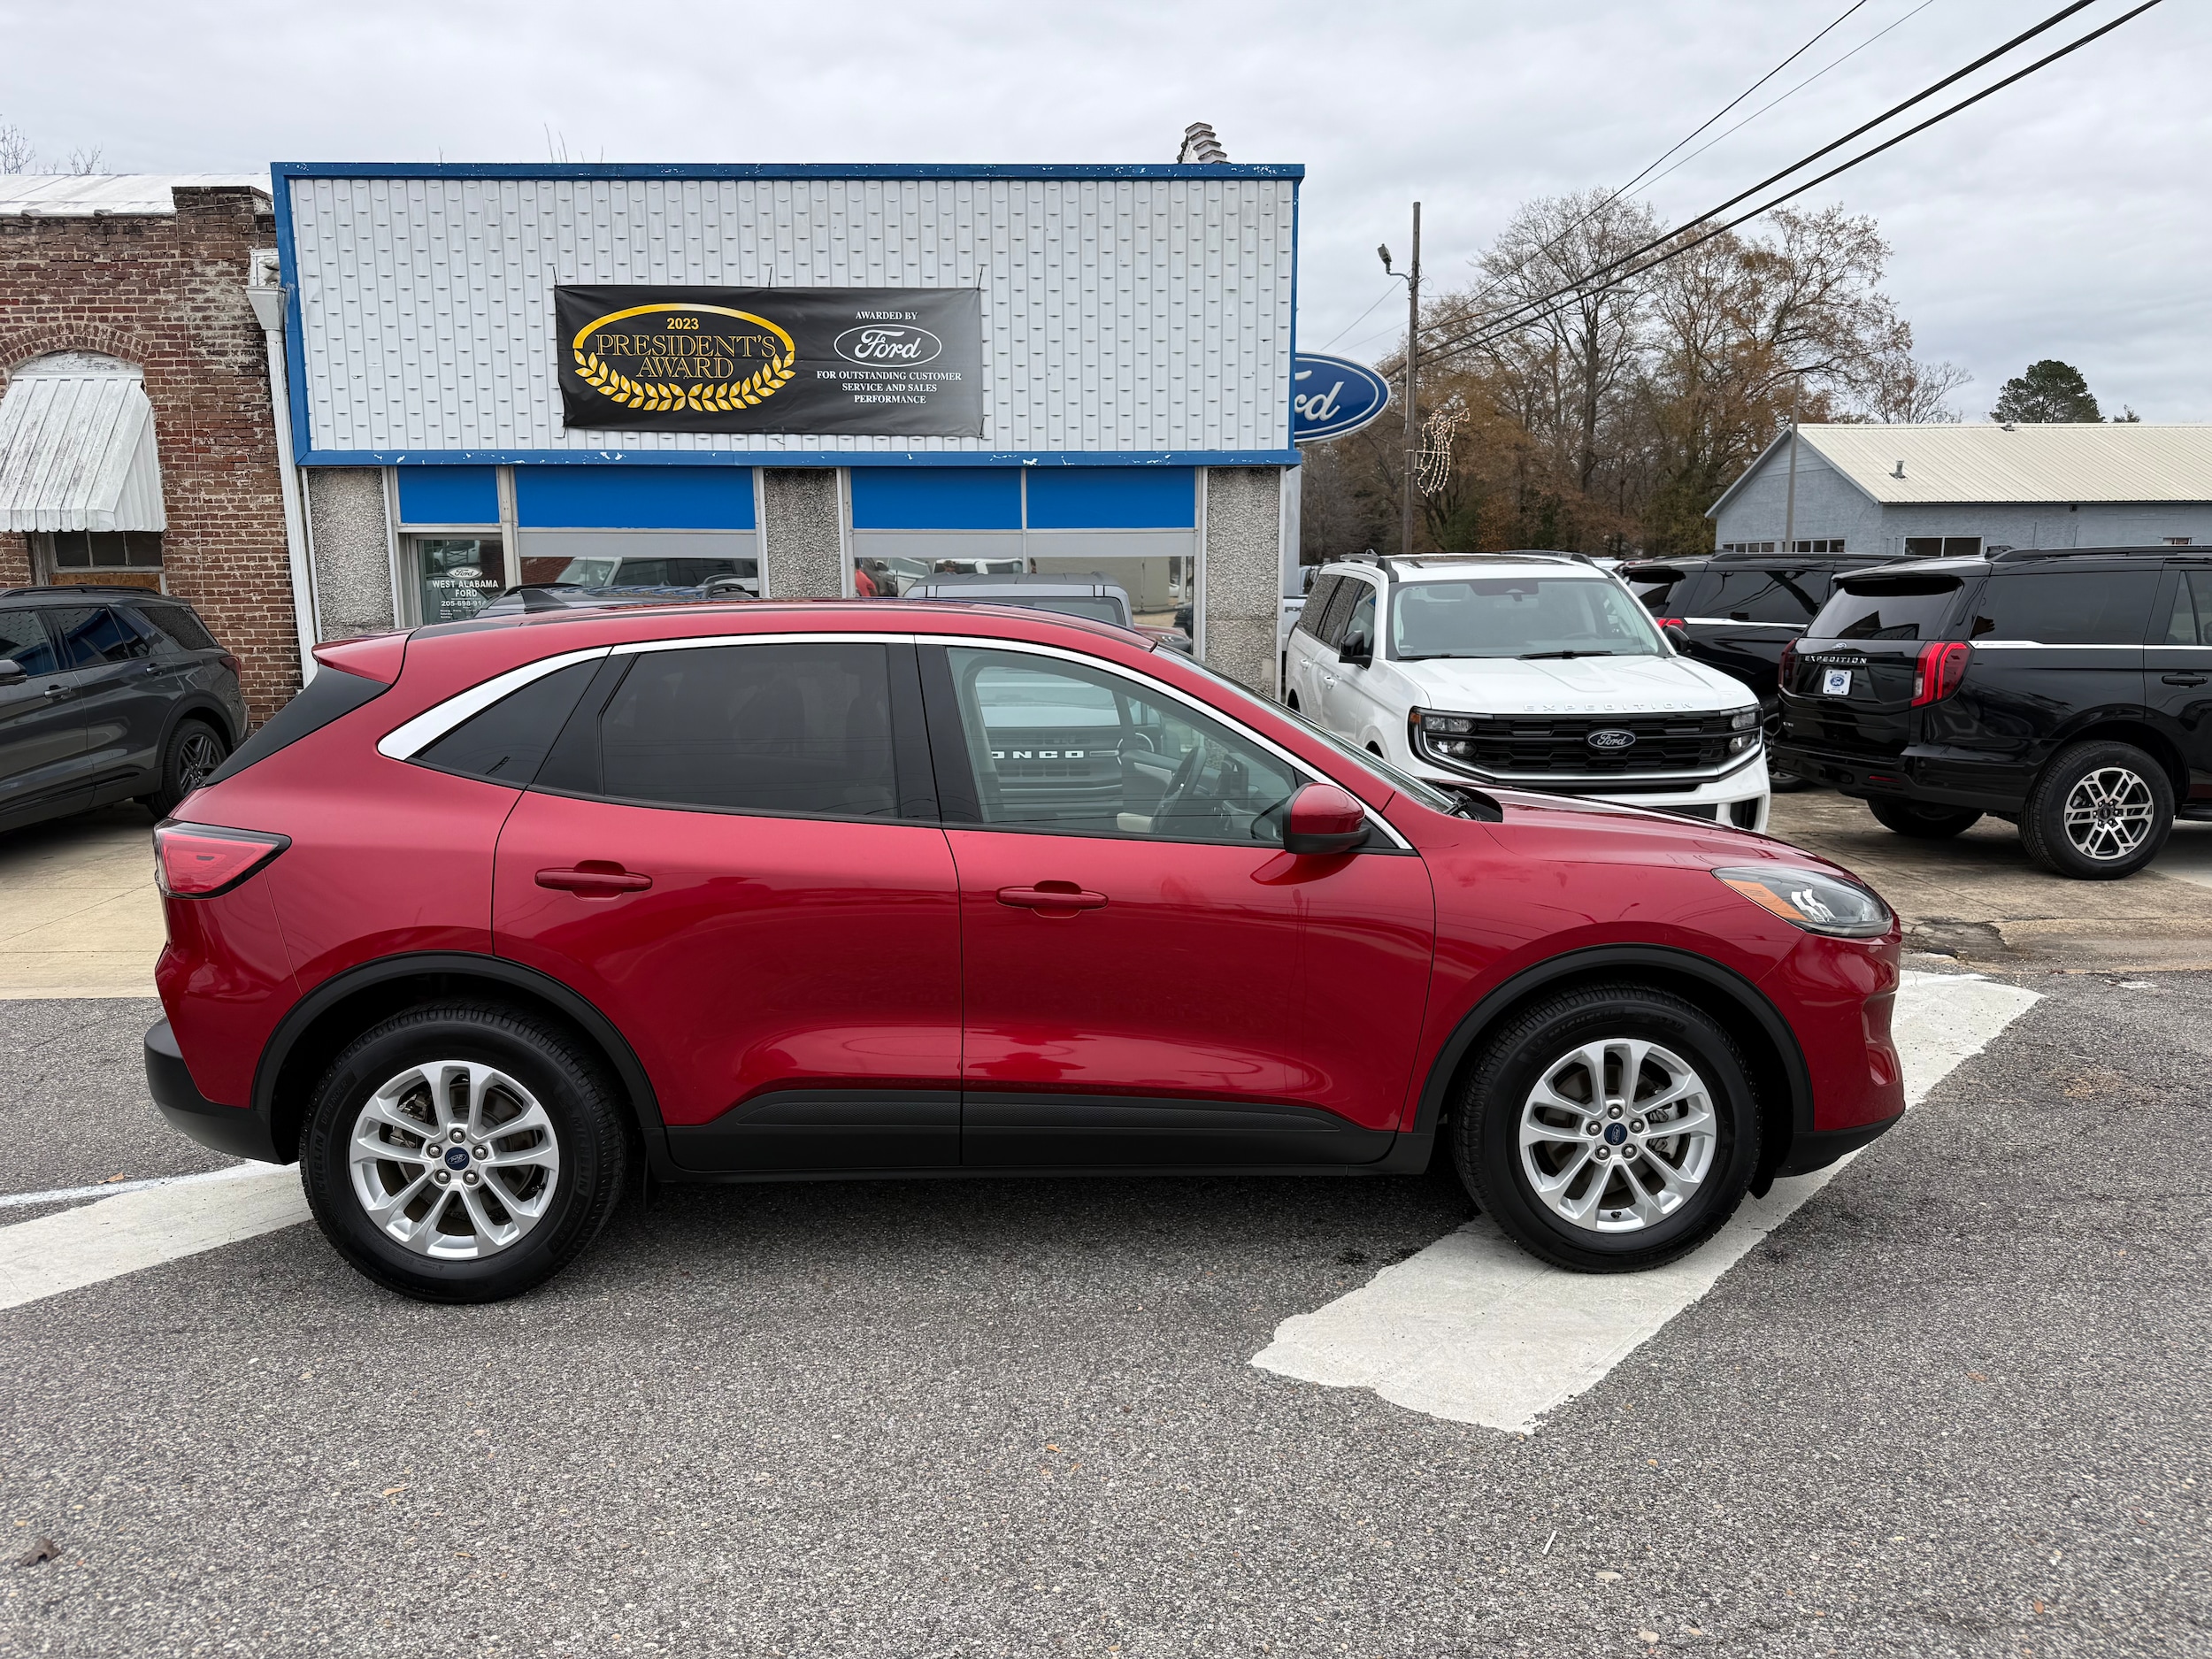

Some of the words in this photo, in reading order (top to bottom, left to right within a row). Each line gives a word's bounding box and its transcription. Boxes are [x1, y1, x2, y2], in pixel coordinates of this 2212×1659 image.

[856, 311, 902, 320] AWARDED
[905, 311, 918, 320] BY
[666, 318, 700, 330] 2023
[595, 334, 776, 357] PRESIDENT'S
[855, 329, 922, 358] Ford
[635, 357, 734, 380] AWARD
[817, 371, 837, 380] FOR
[839, 371, 907, 380] OUTSTANDING
[909, 372, 962, 381] CUSTOMER
[841, 382, 883, 392] SERVICE
[886, 383, 906, 392] AND
[908, 383, 938, 392] SALES
[854, 395, 926, 404] PERFORMANCE
[1294, 370, 1345, 421] rd
[454, 568, 475, 577] Ford
[432, 580, 456, 588] WEST
[458, 580, 499, 588] ALABAMA
[1804, 655, 1868, 664] EXPEDITION
[1523, 701, 1694, 711] EXPEDITION
[1596, 733, 1626, 746] Ford
[992, 750, 1085, 759] ONCO
[320, 1079, 348, 1125] DEFENDER
